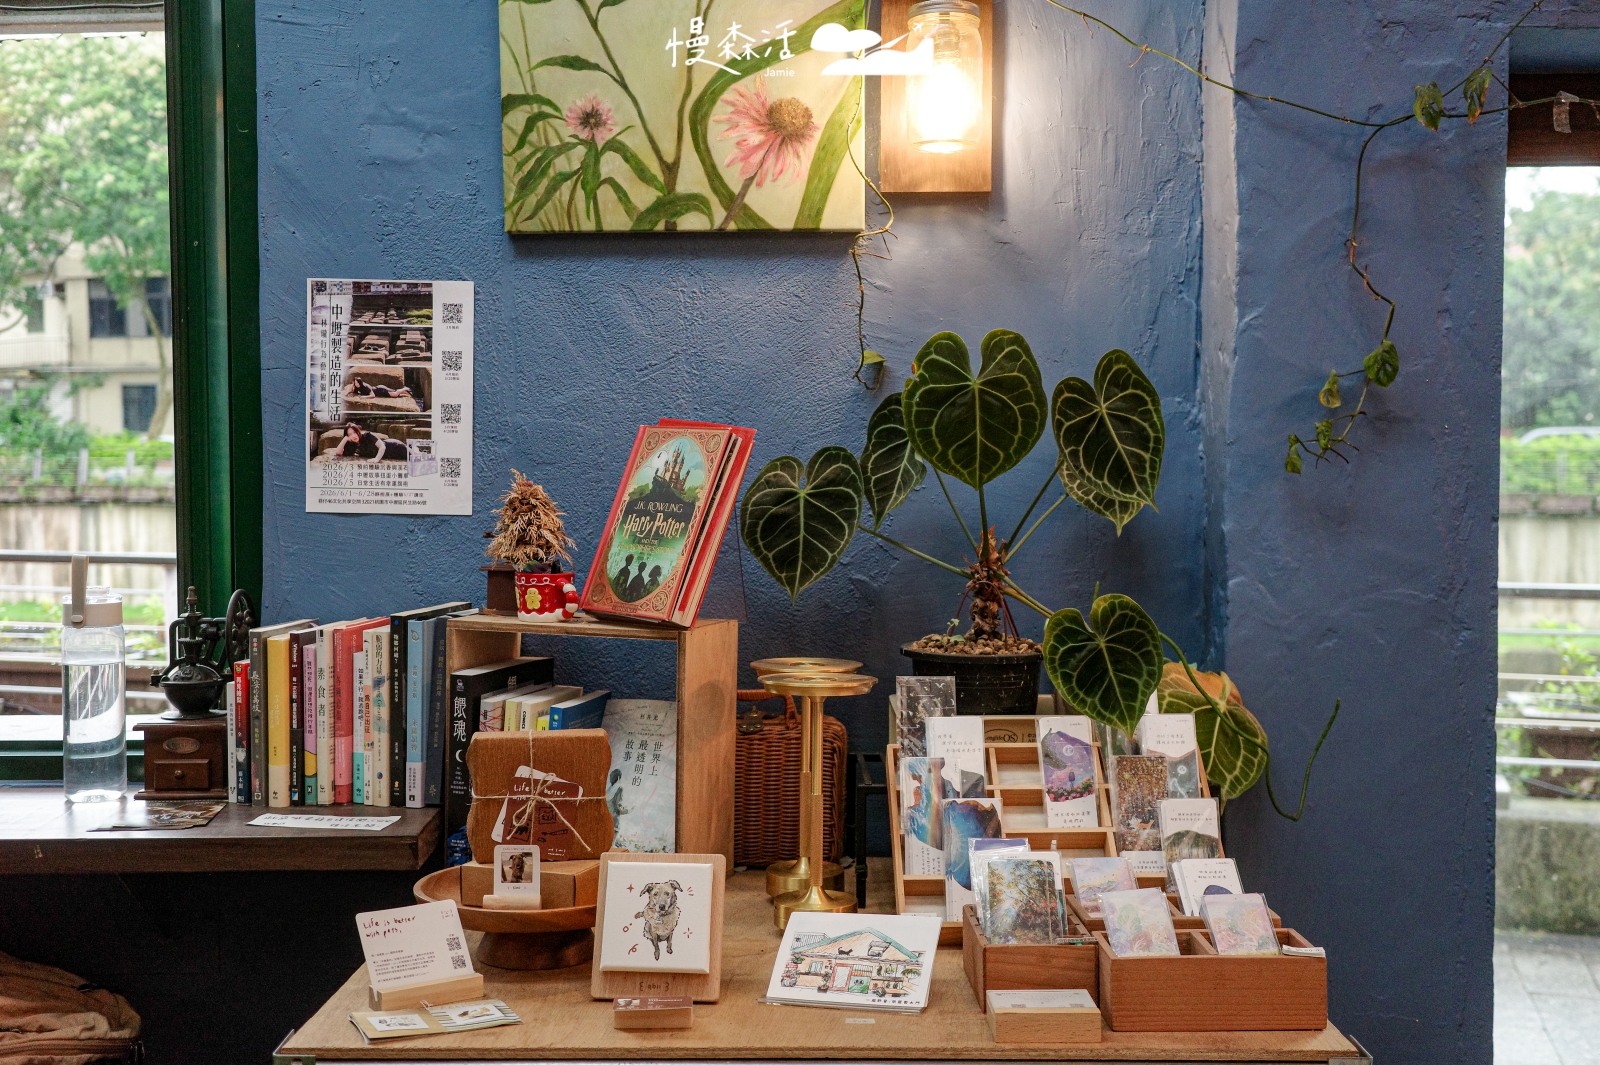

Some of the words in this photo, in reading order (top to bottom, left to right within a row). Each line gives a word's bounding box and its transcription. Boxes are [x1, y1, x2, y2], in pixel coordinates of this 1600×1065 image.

[330, 303, 343, 422] 中壢製造的生活
[322, 463, 354, 472] 2026/3
[322, 471, 354, 480] 2026/4
[322, 479, 354, 488] 2026/5
[648, 501, 684, 512] ROWLING
[623, 512, 654, 539] Harry
[651, 512, 685, 540] Potter
[317, 667, 326, 717] 素食者
[623, 739, 635, 762] 故事
[631, 740, 649, 786] 最透明的
[647, 741, 664, 777] 世界上
[513, 783, 530, 793] Life
[543, 787, 566, 796] better
[363, 917, 380, 929] Life
[384, 919, 391, 927] is
[394, 915, 416, 924] better
[365, 931, 380, 939] with
